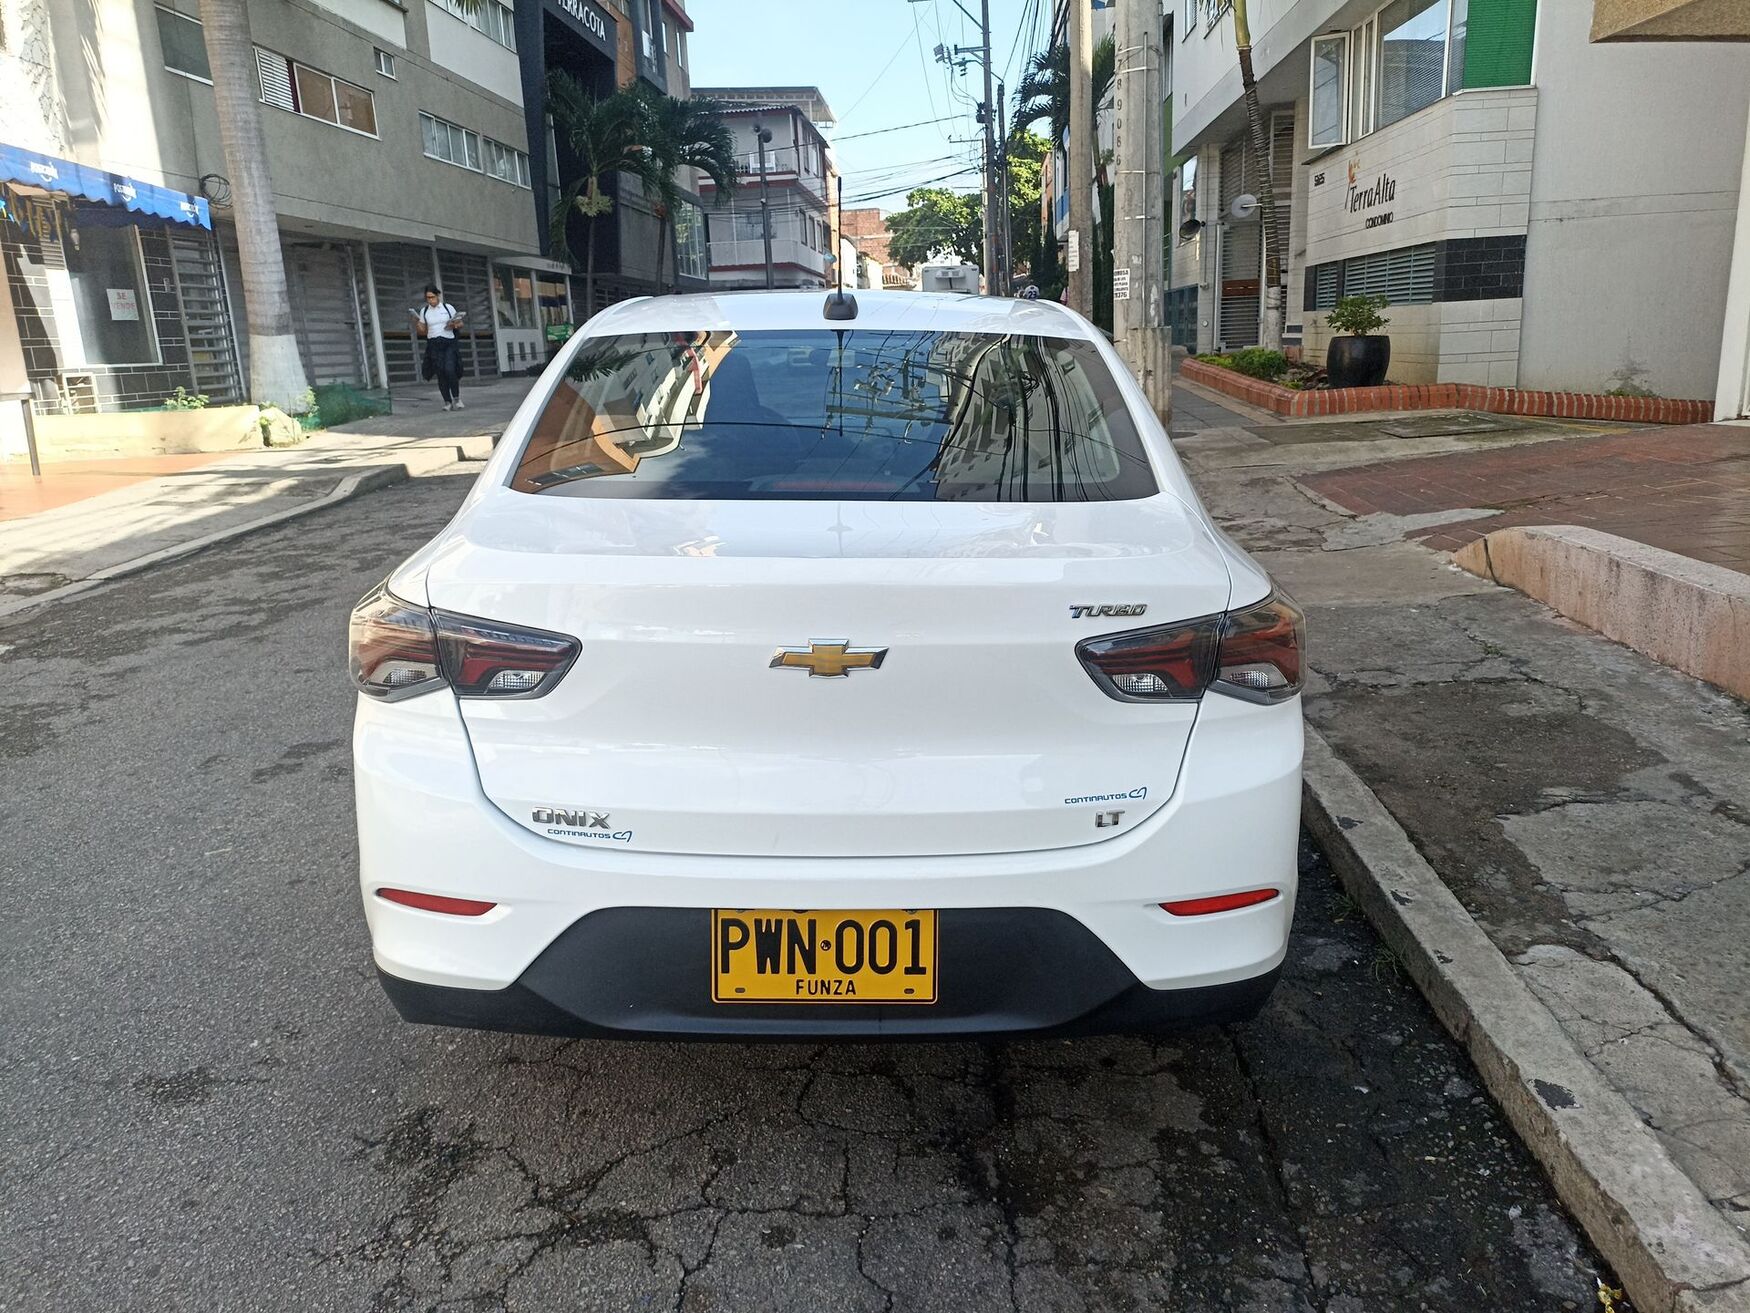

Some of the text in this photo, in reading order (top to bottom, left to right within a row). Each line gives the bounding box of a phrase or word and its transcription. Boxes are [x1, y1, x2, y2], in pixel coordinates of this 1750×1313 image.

[558, 0, 606, 41] RRACOTA
[1069, 604, 1148, 619] TURBO
[1064, 793, 1127, 804] CONTINAUTOS
[531, 806, 610, 829] ONIX
[1095, 809, 1126, 828] LT
[547, 828, 611, 839] CONTINAUTOS
[795, 979, 857, 996] FUNZA
